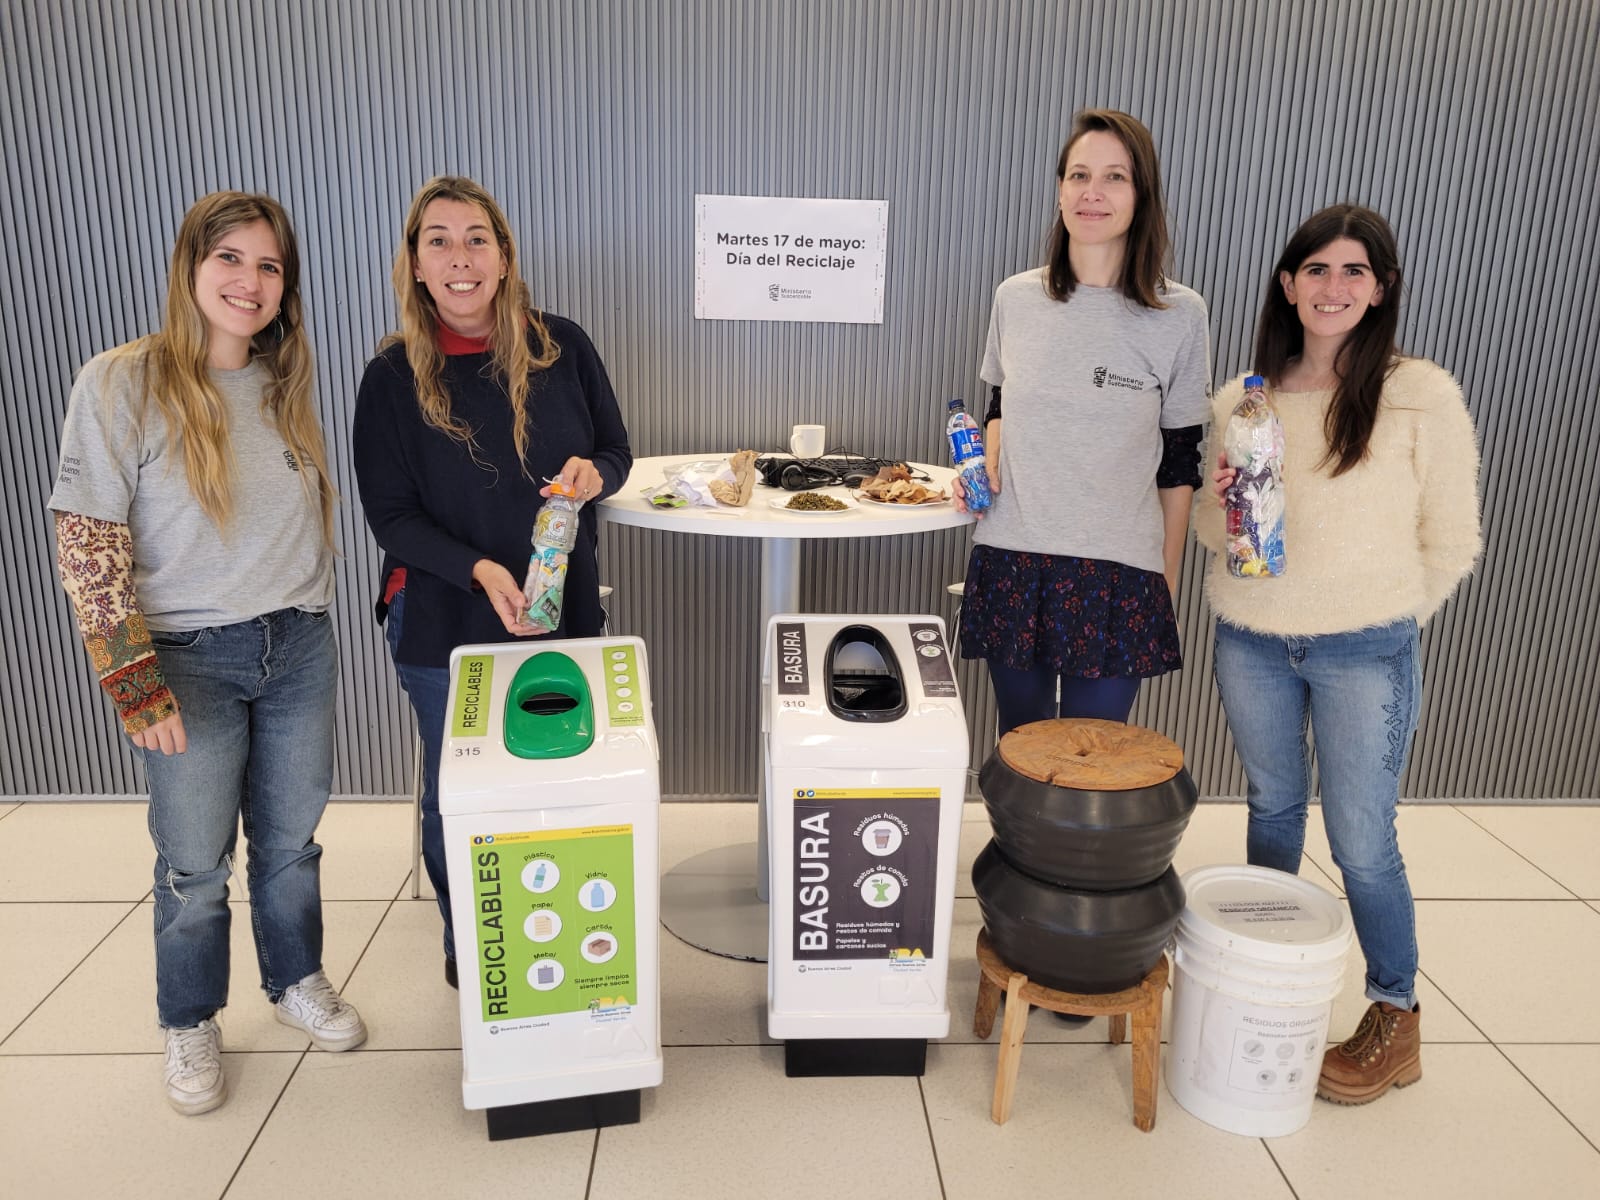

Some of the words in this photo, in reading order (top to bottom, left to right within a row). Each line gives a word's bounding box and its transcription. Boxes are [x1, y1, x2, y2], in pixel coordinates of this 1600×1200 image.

[717, 232, 769, 247] Martes
[774, 234, 789, 247] 17
[794, 235, 814, 248] de
[819, 238, 866, 251] mayo:
[726, 252, 751, 265] Día
[756, 253, 780, 266] del
[786, 254, 855, 271] Reciclaje
[1108, 373, 1144, 386] Ministerio
[783, 631, 803, 684] BASURA
[463, 661, 484, 728] RECICLABLES
[455, 747, 481, 757] 315
[853, 812, 881, 837] Residuos
[523, 851, 555, 861] Plástico
[800, 811, 830, 951] BASURA
[853, 868, 875, 888] Restos
[887, 866, 909, 887] comida
[477, 851, 509, 1016] RECICLABLES
[585, 924, 613, 933] Cartón
[574, 976, 604, 984] Siempre
[605, 973, 630, 981] limpios
[579, 982, 609, 990] siempre
[1242, 1015, 1288, 1029] RESIDUOS
